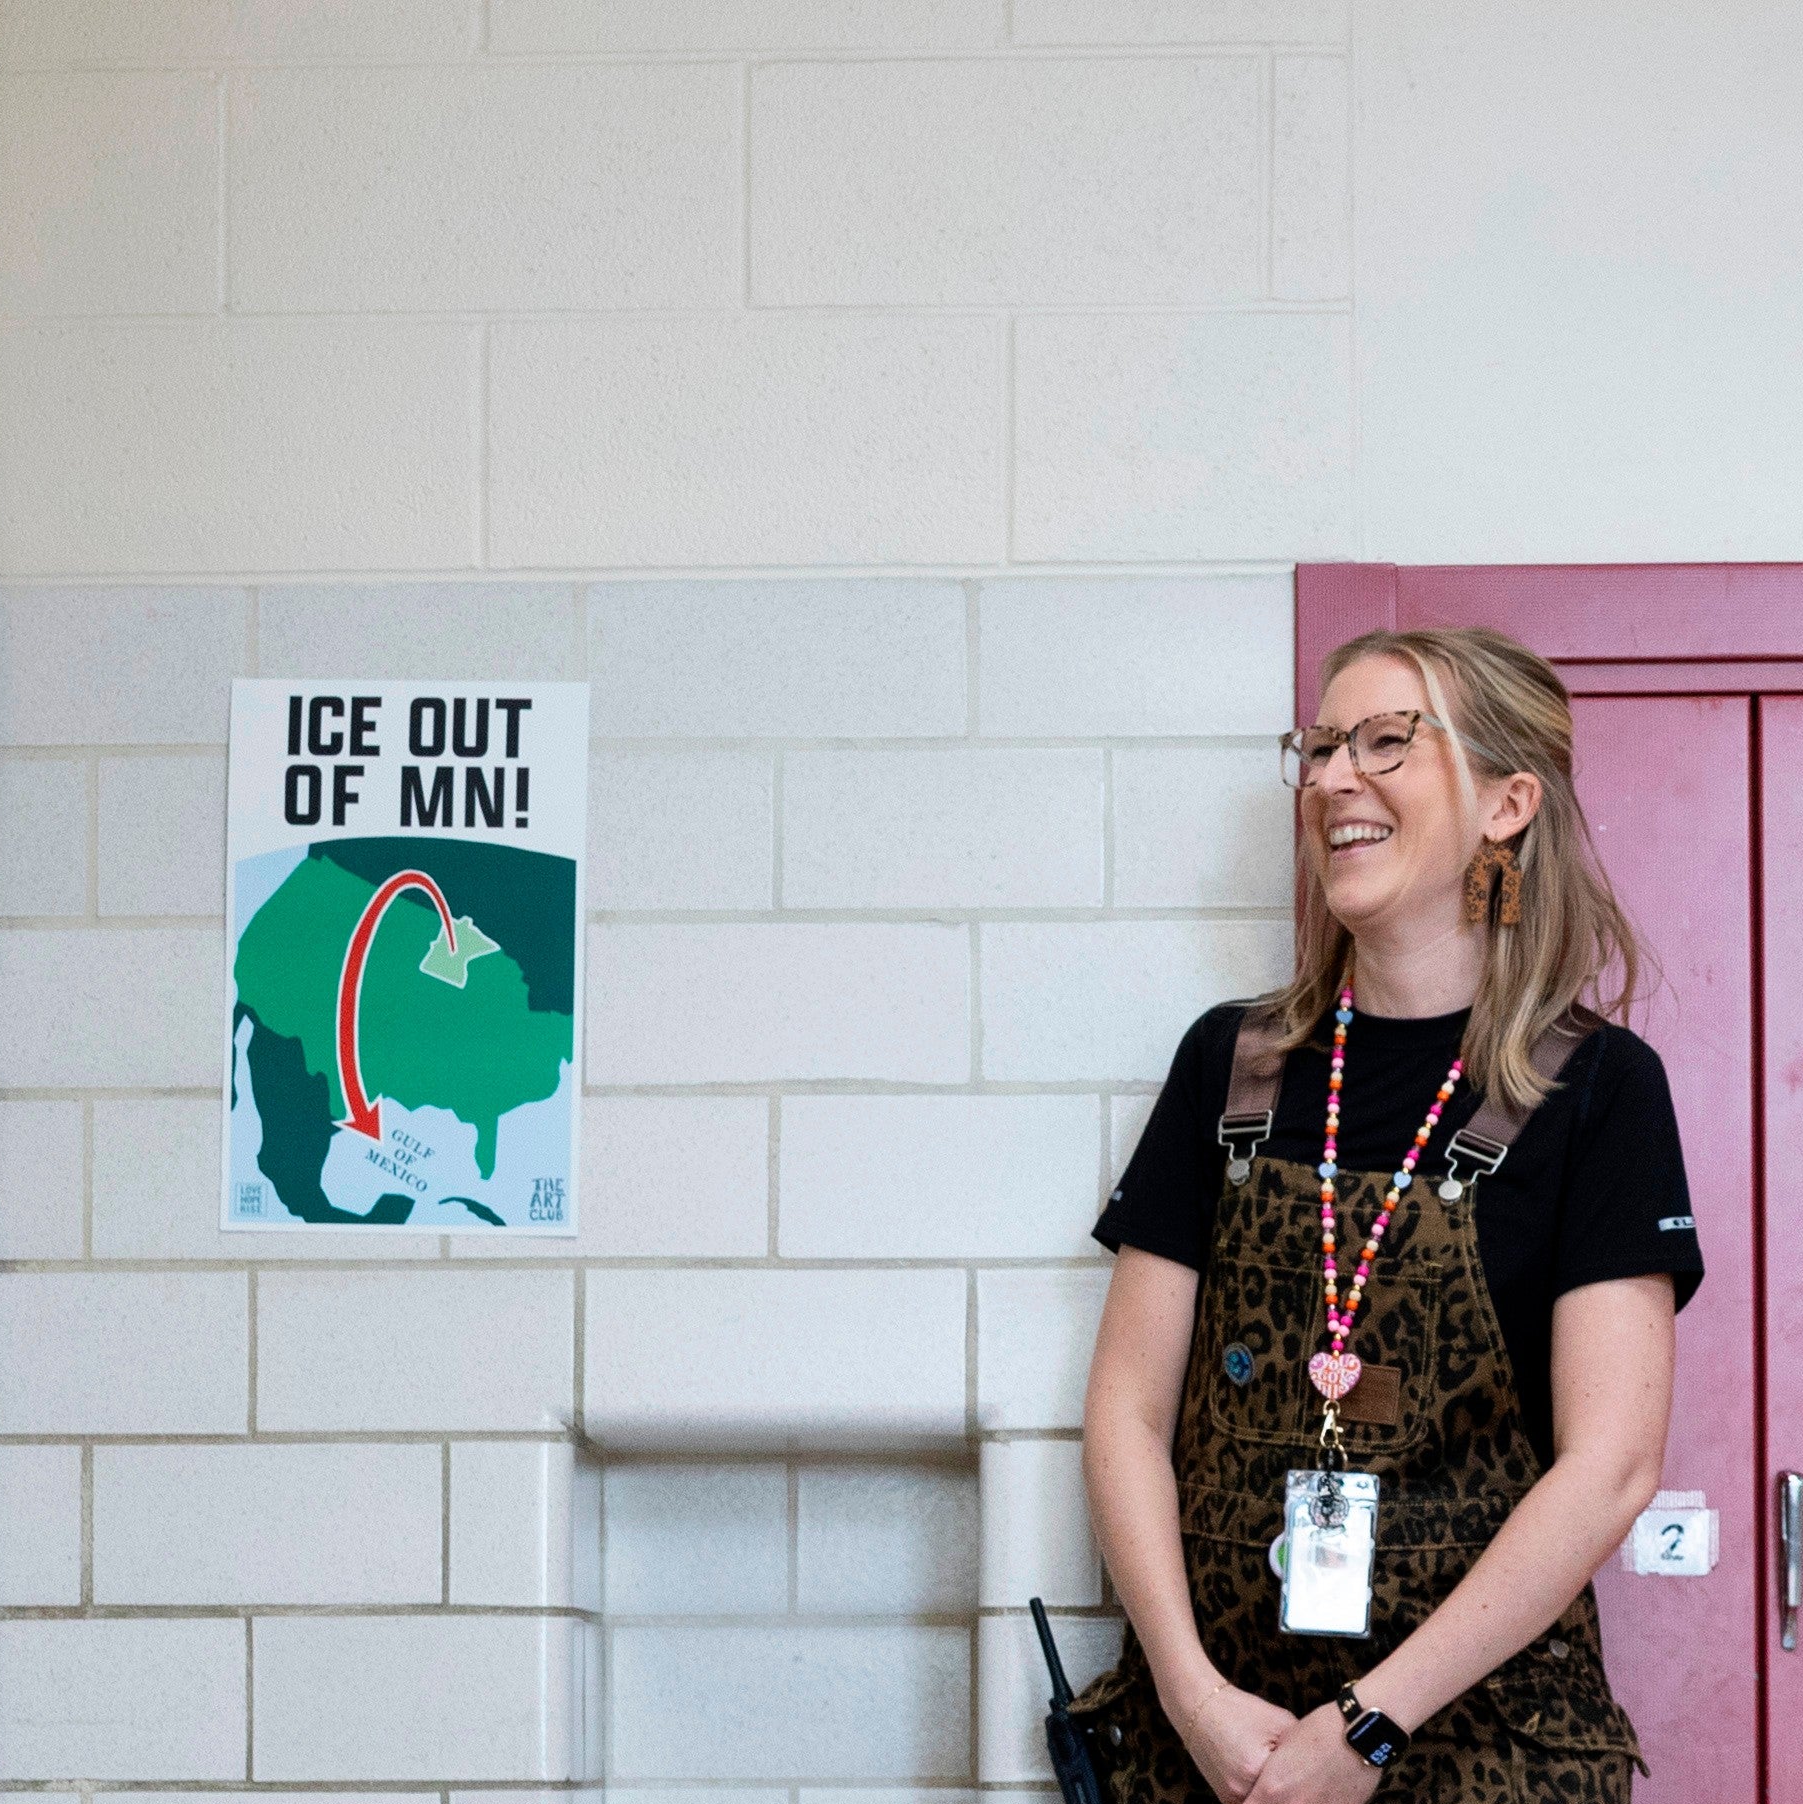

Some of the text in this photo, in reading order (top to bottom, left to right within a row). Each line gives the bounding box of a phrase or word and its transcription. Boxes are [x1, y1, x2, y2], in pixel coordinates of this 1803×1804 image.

[288, 696, 532, 758] ICE OUT
[284, 764, 530, 828] OF MN!
[392, 1129, 436, 1158] GULF
[394, 1148, 417, 1165] OF
[365, 1148, 428, 1192] MEXICO
[532, 1178, 564, 1191] THE
[529, 1208, 564, 1220] CLUB
[530, 1193, 566, 1208] ART
[1661, 1523, 1684, 1560] 2
